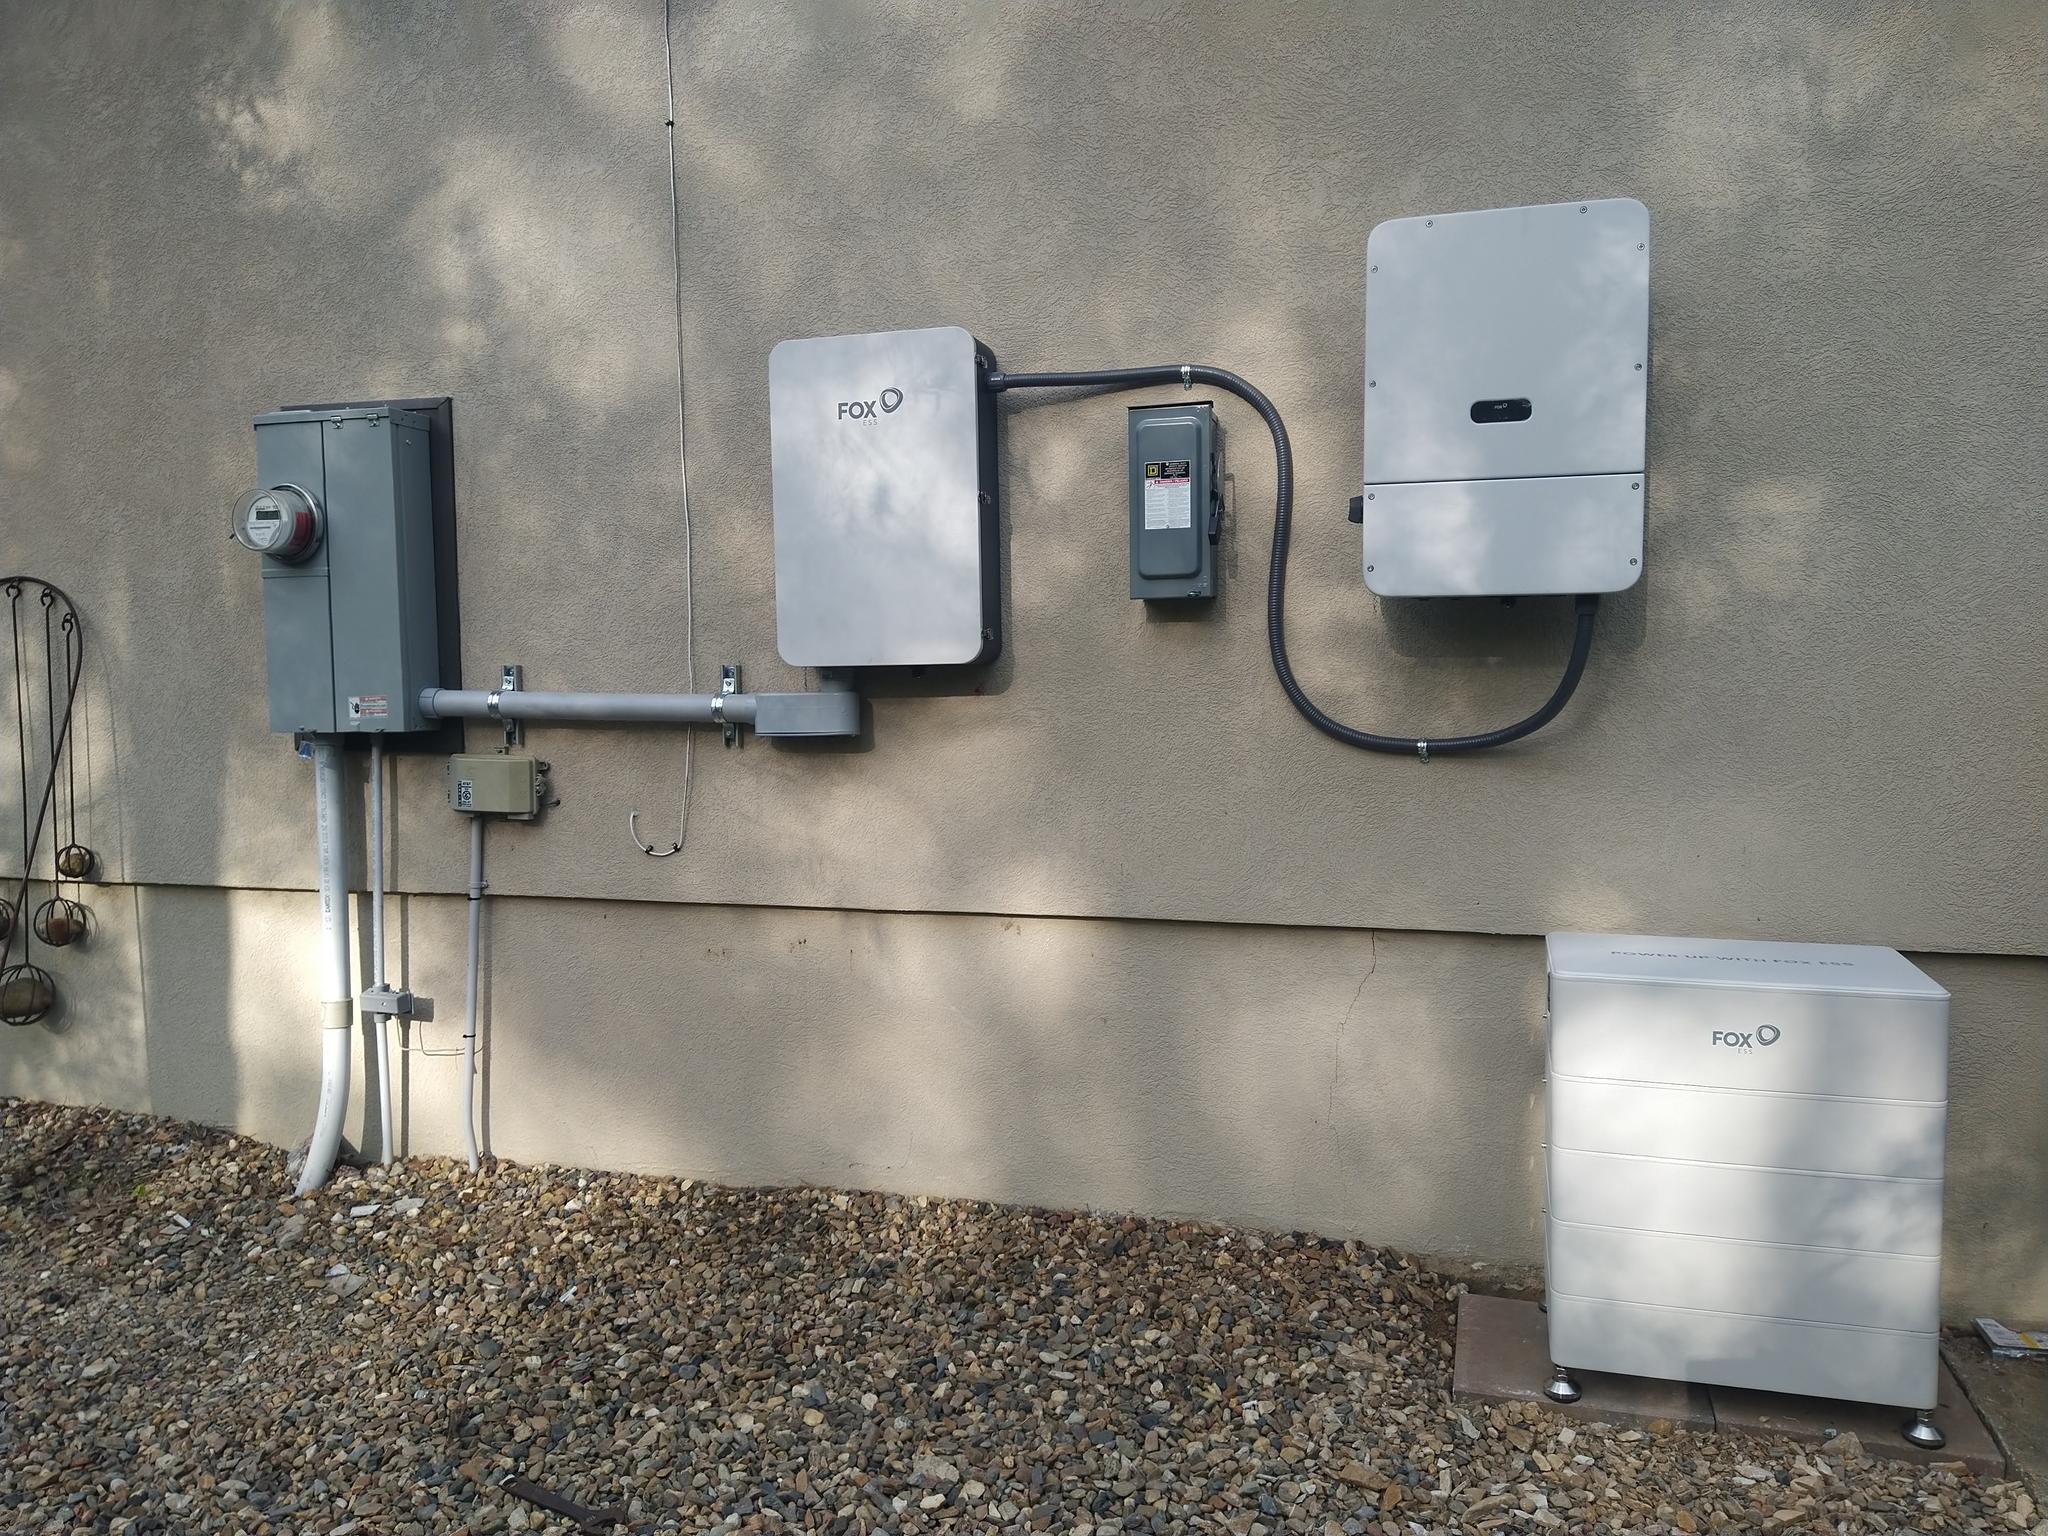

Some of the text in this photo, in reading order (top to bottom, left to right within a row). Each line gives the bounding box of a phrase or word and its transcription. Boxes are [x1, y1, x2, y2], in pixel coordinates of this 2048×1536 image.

[838, 400, 877, 419] FOX
[1611, 950, 1678, 958] POWER
[1716, 955, 1766, 963] WITH
[1712, 1030, 1753, 1048] FOX
